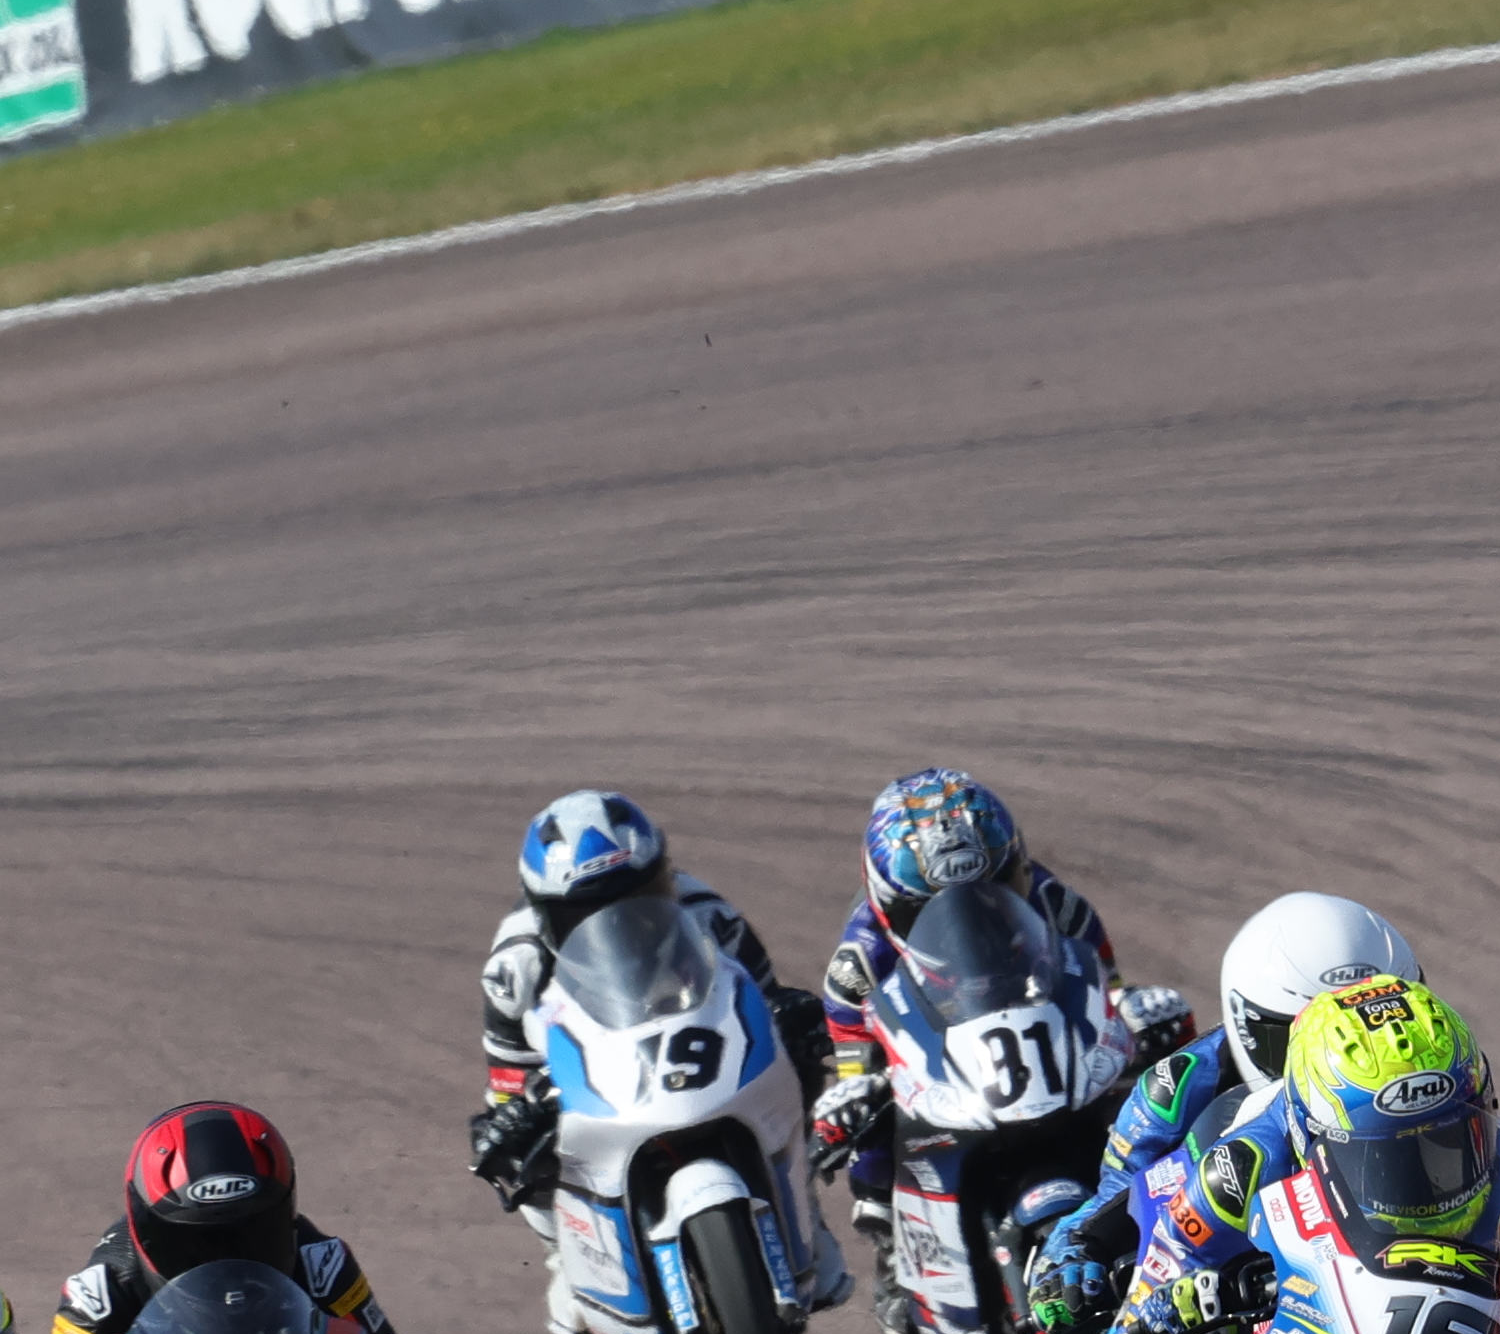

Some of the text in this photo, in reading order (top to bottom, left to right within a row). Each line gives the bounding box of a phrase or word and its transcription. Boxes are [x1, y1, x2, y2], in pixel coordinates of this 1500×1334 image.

[1365, 1000, 1400, 1014] fona
[1369, 1007, 1407, 1025] CAB
[1382, 1075, 1446, 1109] Arai
[202, 1180, 250, 1201] HJC
[1214, 1145, 1243, 1207] RST
[1291, 1172, 1322, 1230] MOTUL
[1388, 1243, 1488, 1277] RK
